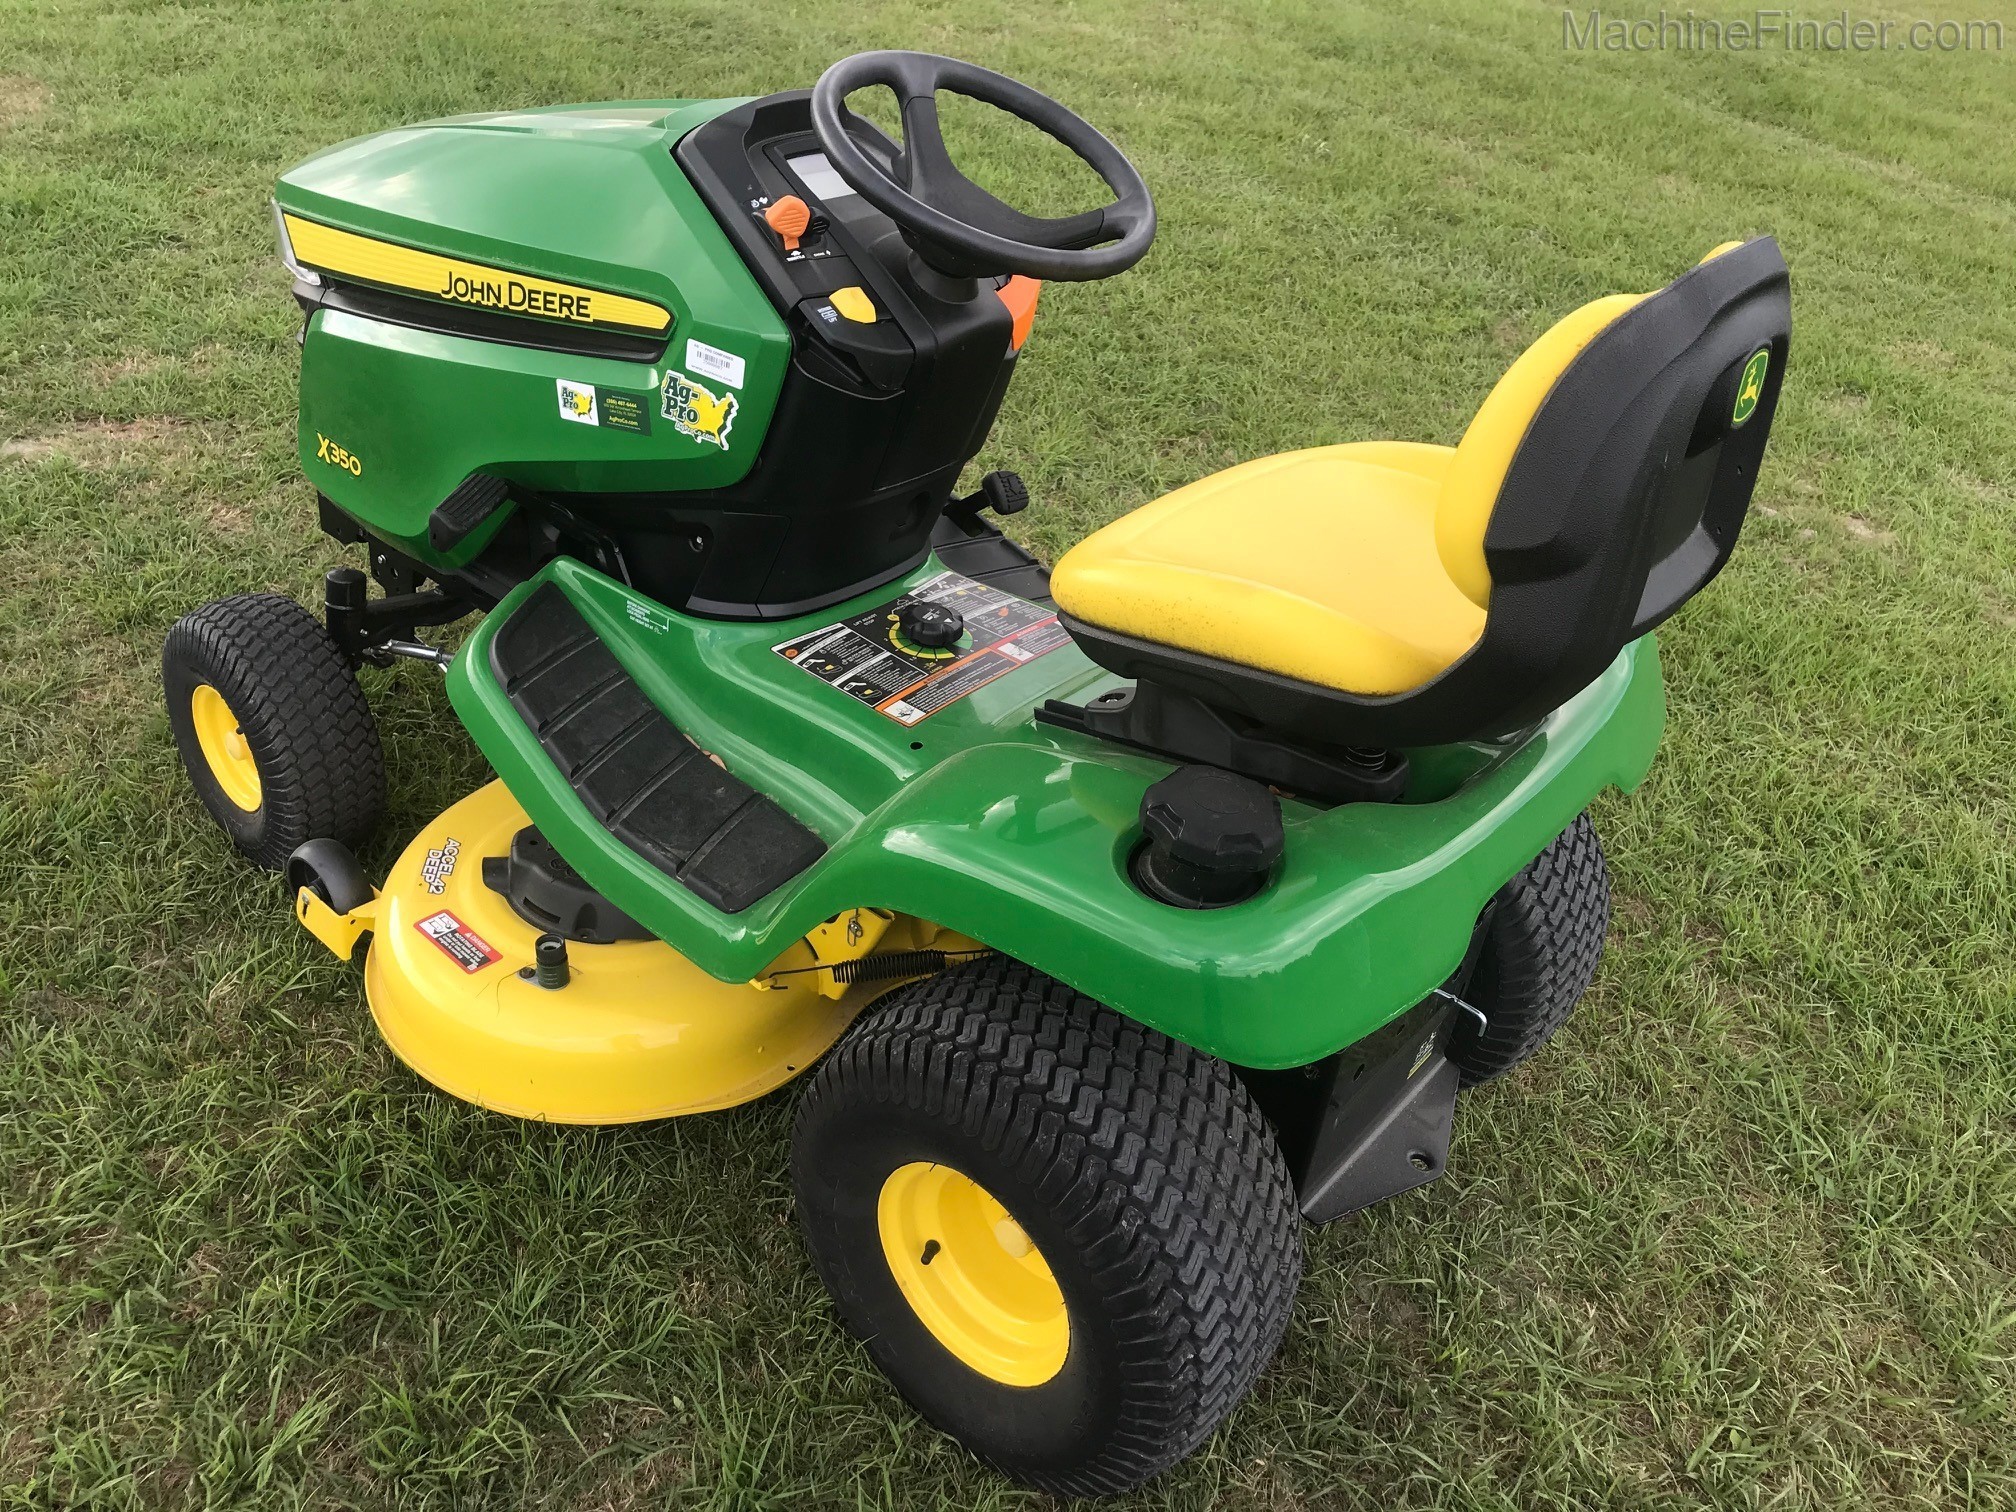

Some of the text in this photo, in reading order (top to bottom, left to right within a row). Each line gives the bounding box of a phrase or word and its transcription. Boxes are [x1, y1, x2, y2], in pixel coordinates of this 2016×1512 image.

[441, 271, 591, 319] JOHN DEERE
[563, 397, 579, 409] Pro
[664, 375, 699, 405] Ag-
[664, 395, 699, 423] Pro
[316, 431, 362, 477] X350
[421, 848, 443, 884] DEEP
[470, 935, 492, 953] DANGER
